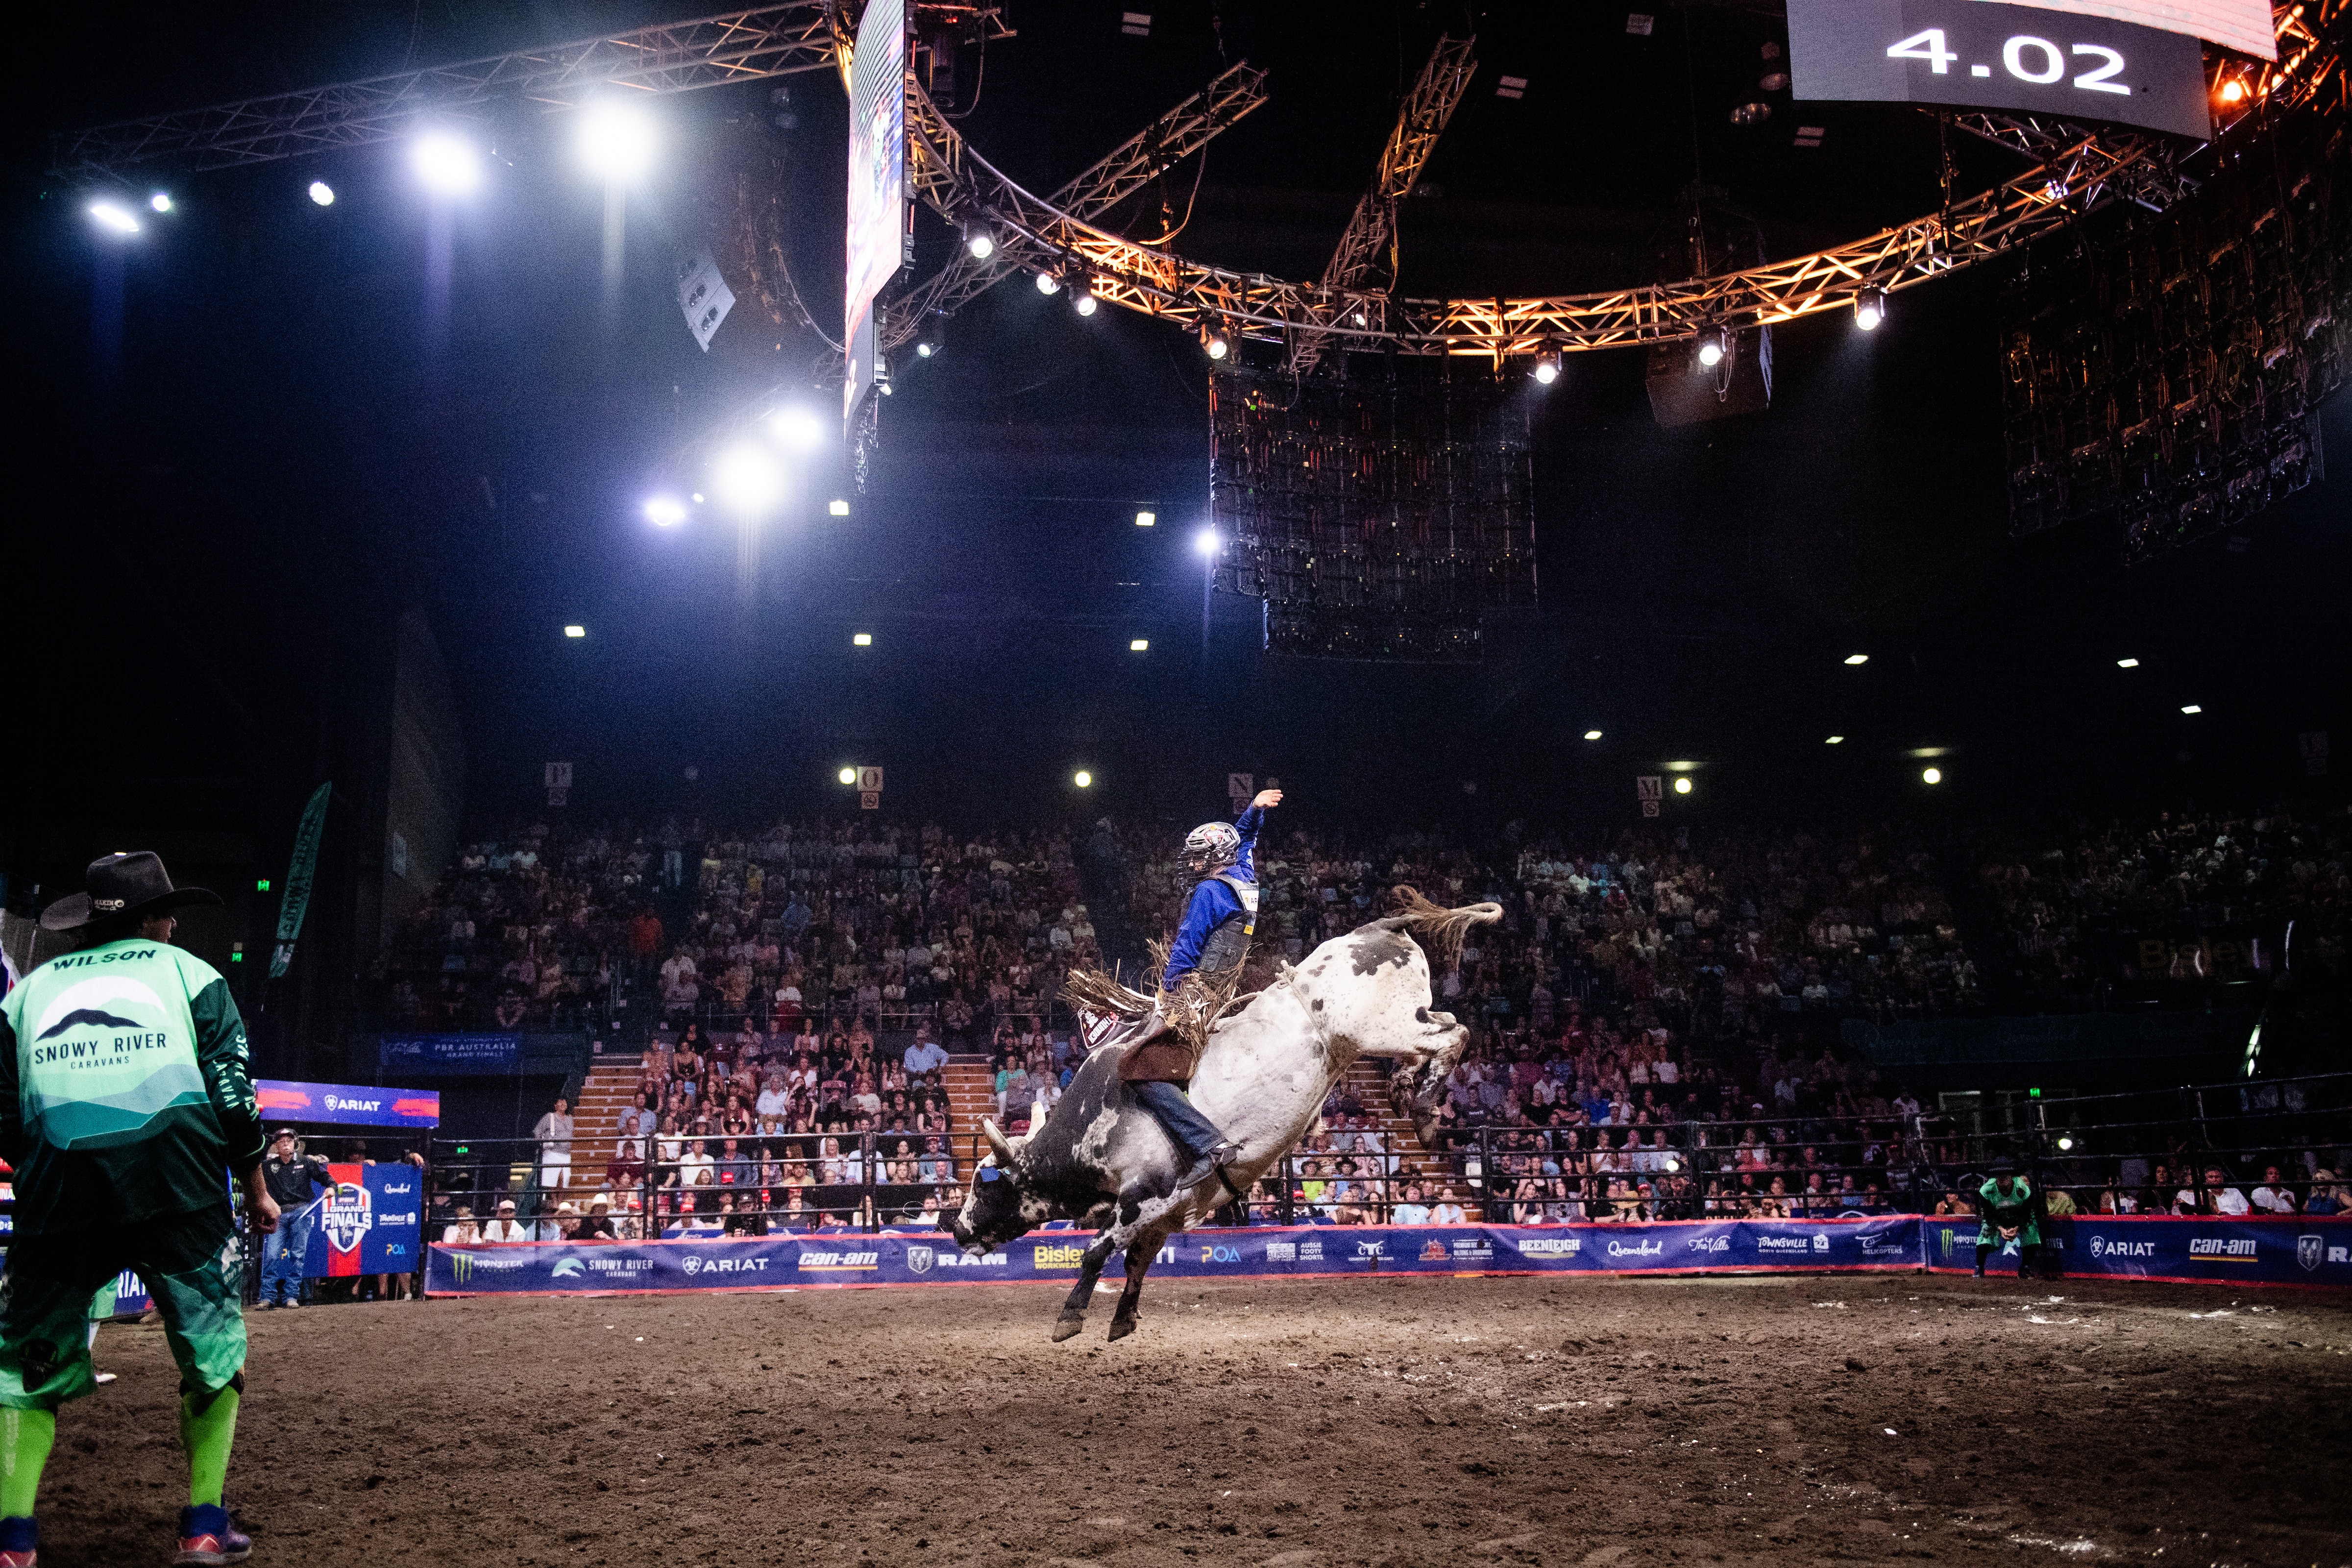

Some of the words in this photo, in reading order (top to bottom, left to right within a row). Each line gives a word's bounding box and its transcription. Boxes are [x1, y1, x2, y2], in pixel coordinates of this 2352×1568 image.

[1886, 28, 2131, 95] 4.02
[54, 950, 156, 971] WILSON
[1087, 1015, 1114, 1044] THUNDER
[35, 1040, 98, 1064] SNOWY
[115, 1033, 167, 1053] RIVER
[71, 1056, 129, 1070] CARAVANS
[338, 1101, 380, 1112] ARIAT
[321, 1212, 372, 1232] FINALS
[1518, 1239, 1581, 1252] BEENLEIGH
[1689, 1238, 1708, 1251] The
[1705, 1235, 1730, 1253] Ville
[1757, 1236, 1808, 1248] TOWNSVILLE
[1953, 1235, 1978, 1244] MONSTE
[2189, 1238, 2257, 1255] can-am
[1034, 1245, 1084, 1263] Bisle
[1608, 1239, 1663, 1256] Queensland
[2105, 1241, 2156, 1256] ARIAT
[474, 1260, 524, 1269] MONSTER
[589, 1259, 622, 1271] SNOWY
[627, 1259, 654, 1270] RIVER
[703, 1258, 769, 1273] ARIAT
[798, 1252, 878, 1266] can-am
[938, 1253, 1007, 1266] RAM
